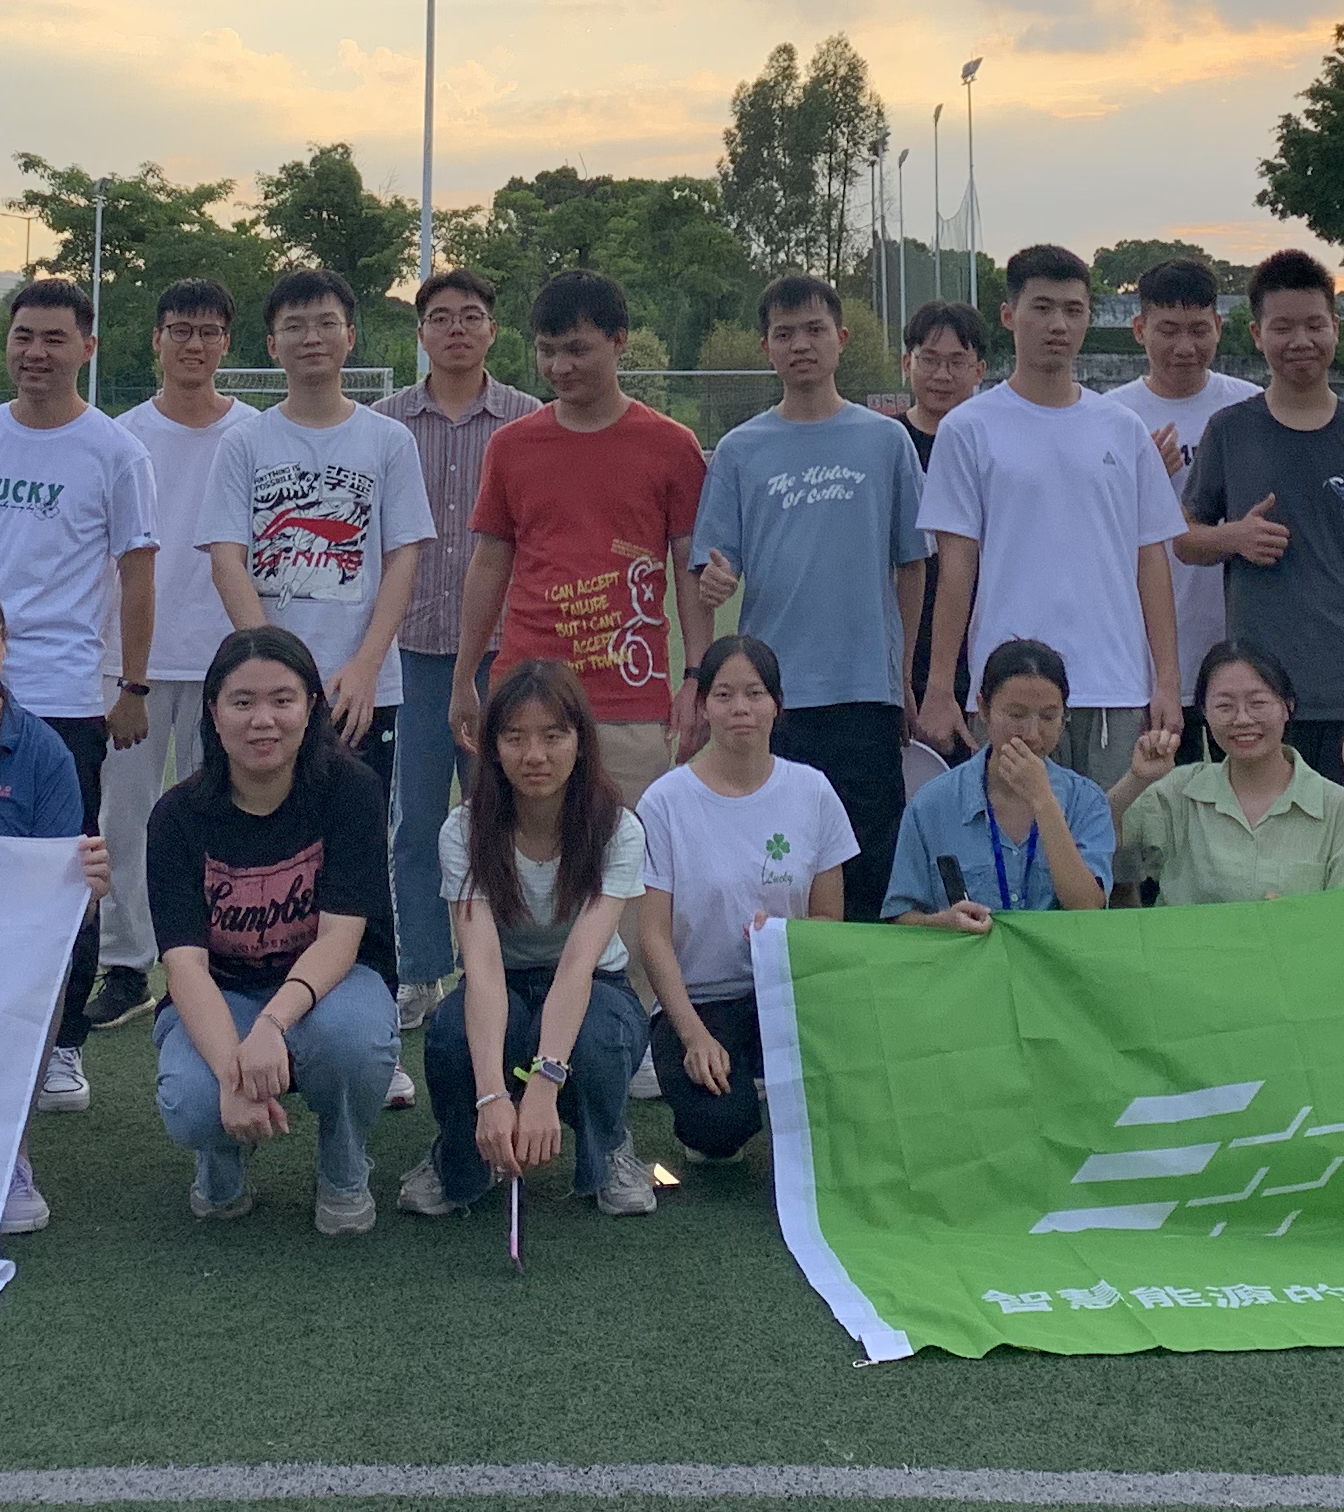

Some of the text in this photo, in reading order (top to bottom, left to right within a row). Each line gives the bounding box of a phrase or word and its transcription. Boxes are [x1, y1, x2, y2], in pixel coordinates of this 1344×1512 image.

[768, 472, 796, 496] The
[807, 484, 854, 504] Coffee
[551, 582, 575, 602] CAN
[577, 571, 620, 596] ACCEPT
[560, 594, 609, 617] FAILURE
[555, 619, 579, 637] BUT
[205, 873, 316, 943] Campbe
